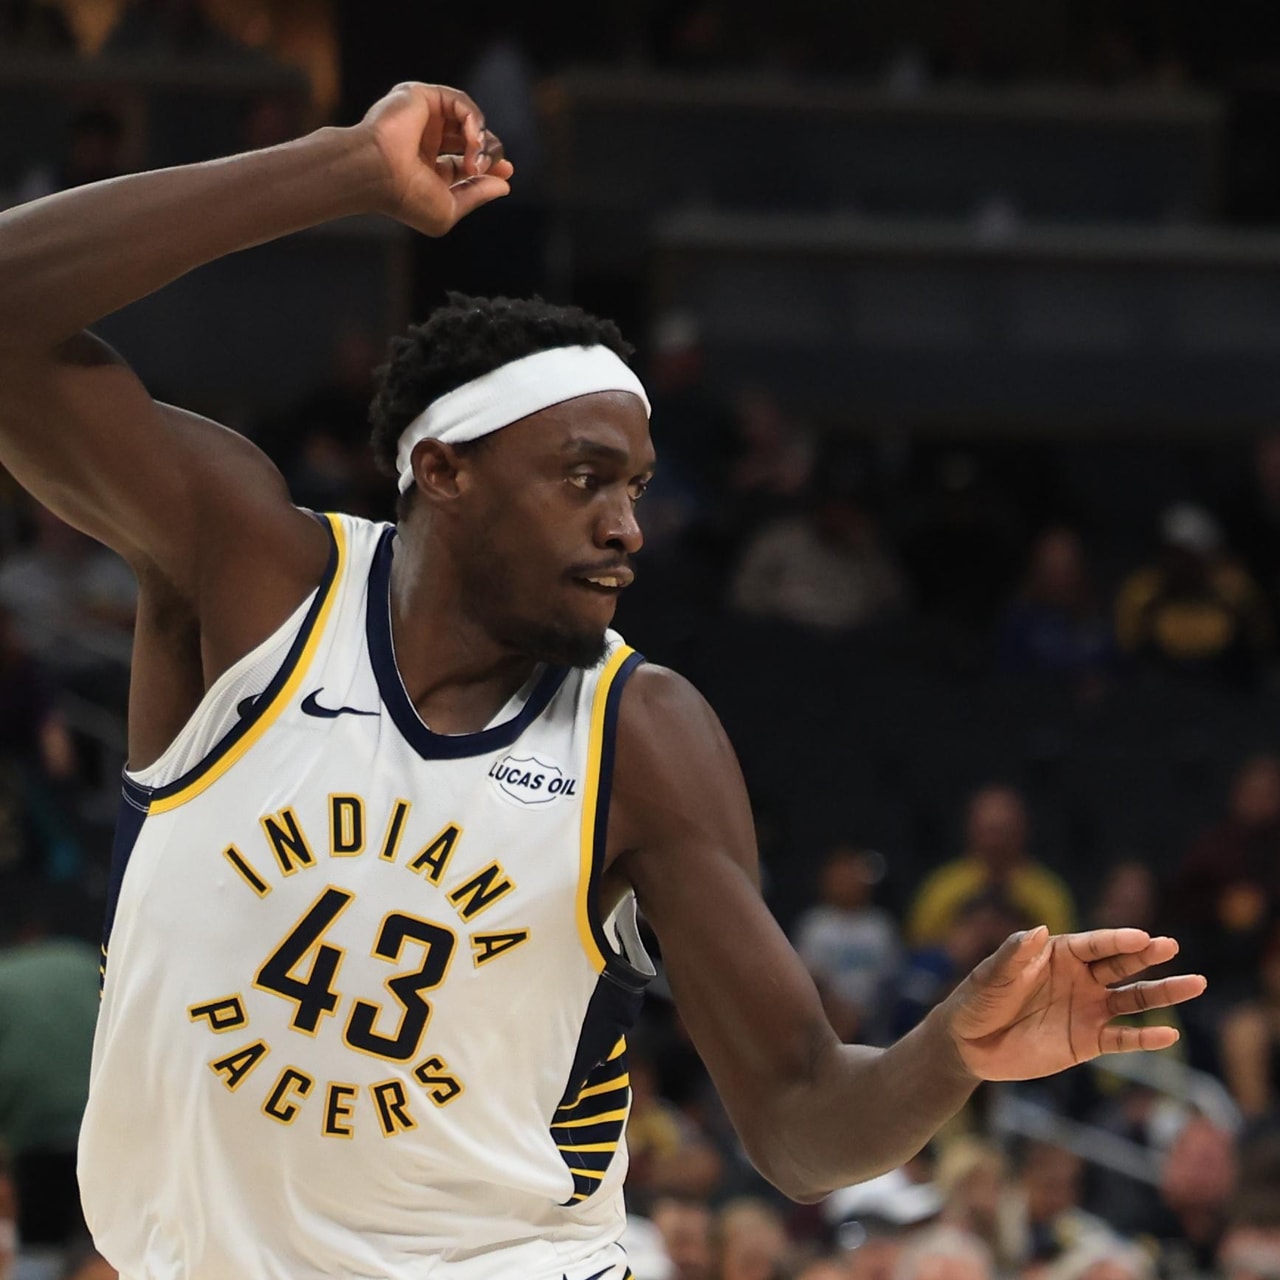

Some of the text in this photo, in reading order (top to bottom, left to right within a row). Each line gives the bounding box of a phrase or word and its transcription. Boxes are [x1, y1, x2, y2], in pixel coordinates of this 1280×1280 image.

[488, 762, 576, 795] LUCAS OIL
[223, 793, 531, 967] INDIANA
[252, 884, 458, 1061] 43
[188, 993, 464, 1138] PACERS
